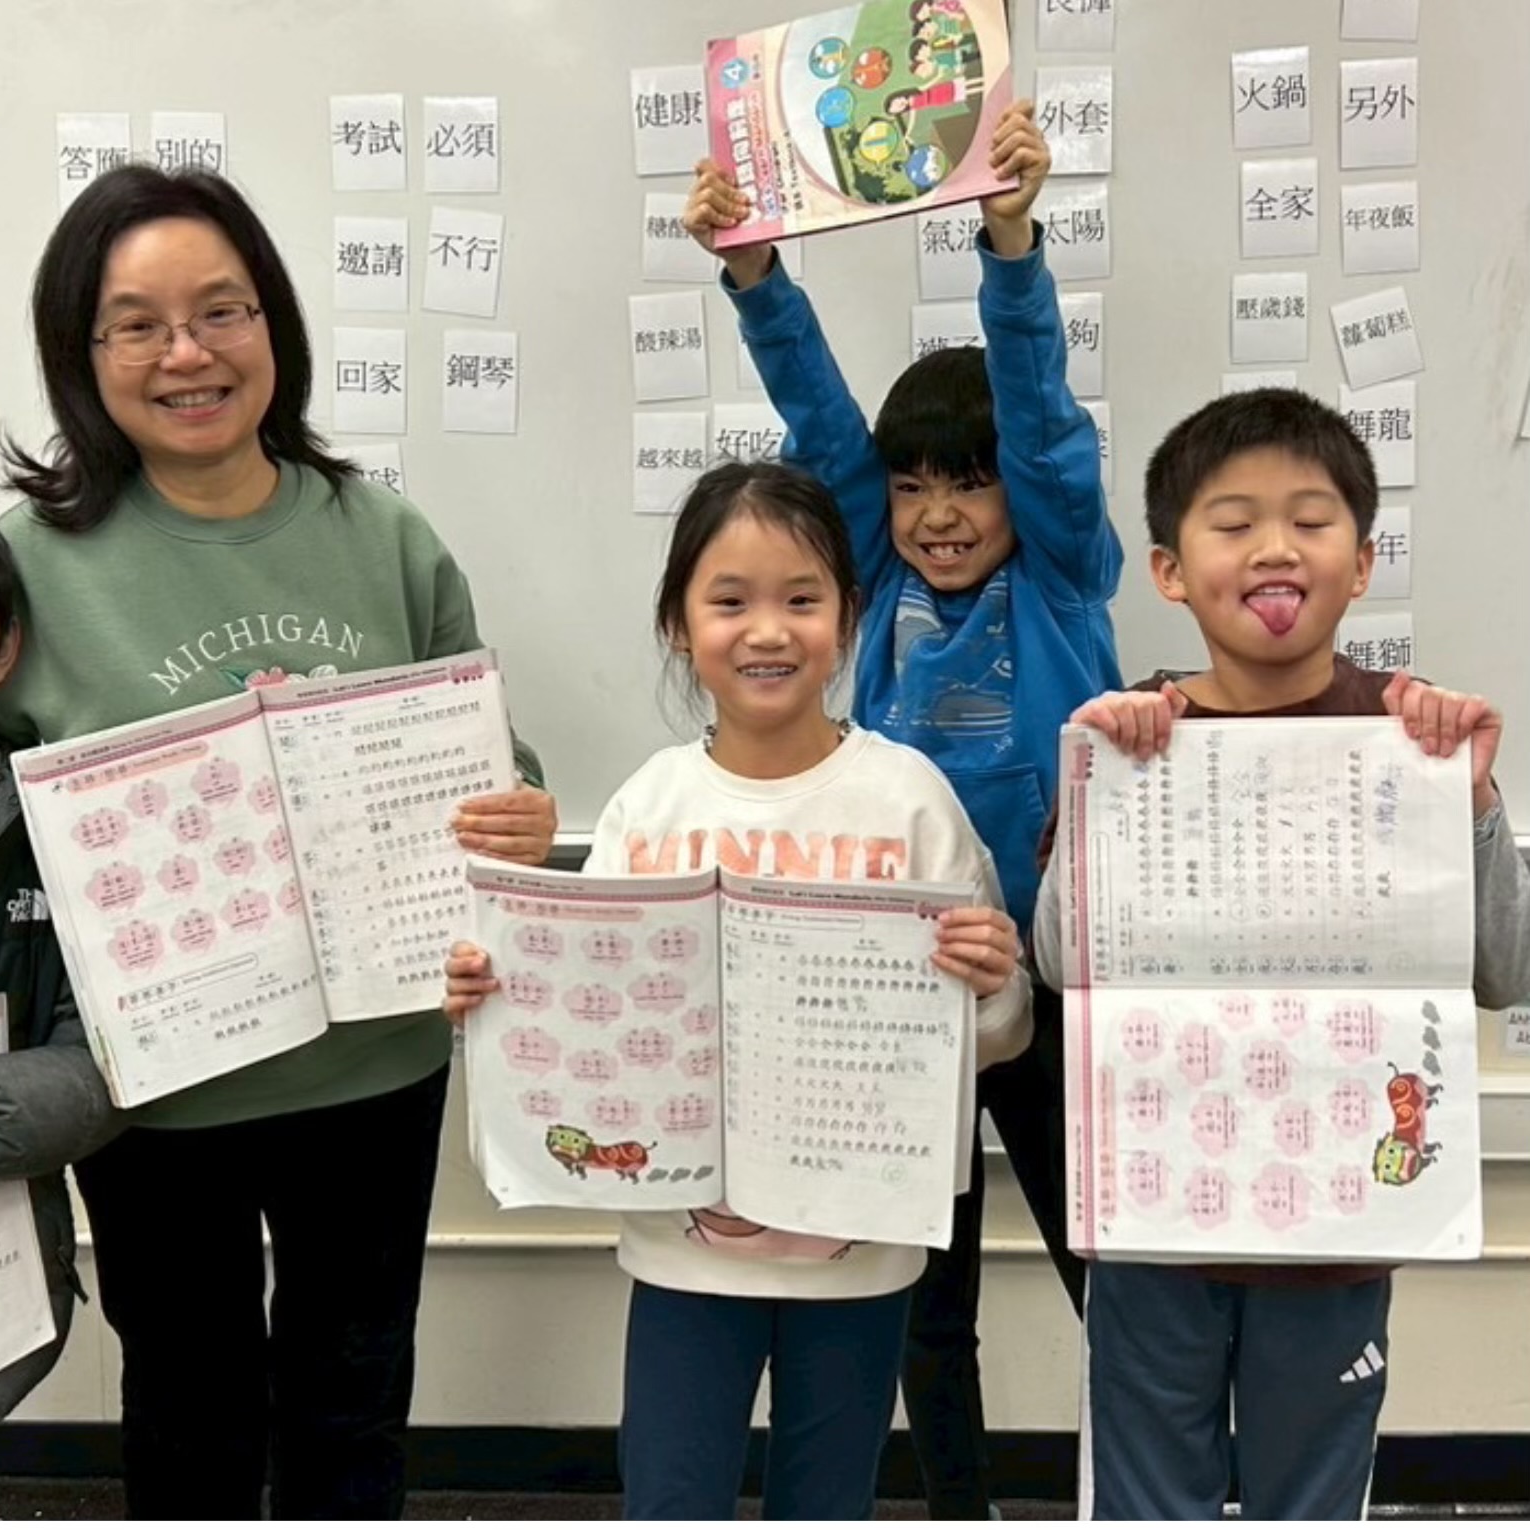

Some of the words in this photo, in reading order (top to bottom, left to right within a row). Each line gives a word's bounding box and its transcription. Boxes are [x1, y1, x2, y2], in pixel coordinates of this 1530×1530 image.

[636, 91, 703, 128] 健康
[1237, 74, 1306, 112] 火鍋
[1345, 86, 1415, 120] 另外
[1040, 101, 1109, 136] 外套
[334, 120, 402, 155] 考試
[427, 122, 495, 157] 必須
[155, 138, 222, 174] 別的
[1245, 187, 1314, 222] 全家
[1345, 204, 1415, 231] 年夜飯
[1041, 211, 1104, 245] 太陽
[337, 242, 403, 276] 邀請
[431, 233, 498, 272] 不行
[1237, 295, 1304, 319] 壓歲錢
[635, 327, 702, 353] 酸辣湯
[1342, 309, 1411, 347] 蘿蔔糕
[336, 360, 402, 394] 回家
[447, 353, 514, 389] 鋼琴
[637, 446, 703, 469] 越來越
[717, 428, 782, 462] 好吃
[148, 613, 365, 695] MICHIGAN
